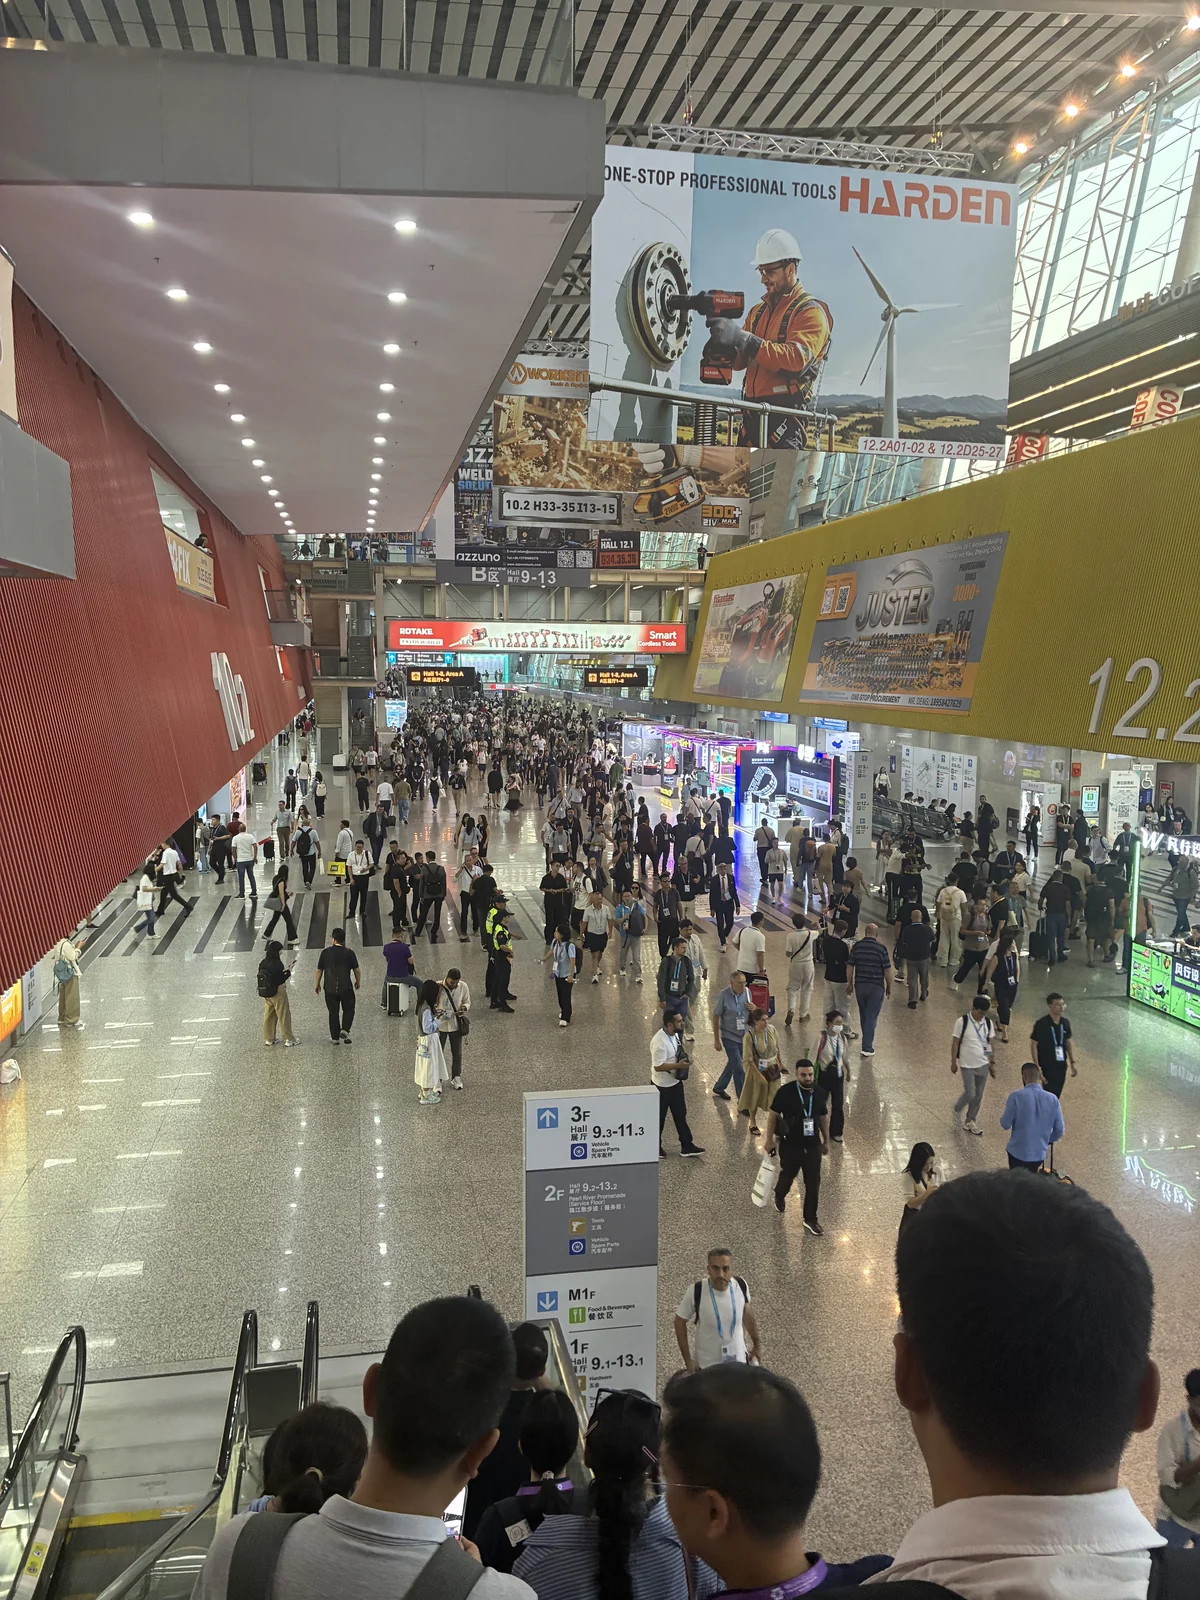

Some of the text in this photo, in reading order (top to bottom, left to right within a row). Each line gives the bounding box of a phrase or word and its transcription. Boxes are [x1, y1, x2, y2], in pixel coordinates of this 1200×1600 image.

[604, 165, 836, 200] ONE-STOP PROFESSIONAL TOOLS
[839, 176, 1011, 226] HARDEN
[863, 439, 1003, 458] 12.2A01-02 & 12.2D25-27
[506, 500, 530, 511] 10.2
[533, 501, 576, 512] H33-35
[600, 540, 634, 549] HALL 12.1
[456, 553, 501, 562] azzuno
[472, 567, 487, 581] B
[521, 570, 557, 584] 9-13
[953, 584, 980, 601] 3000+
[856, 585, 935, 631] JUSTER
[649, 631, 677, 639] Smart
[870, 695, 900, 703] PROCUREMENT
[1088, 657, 1200, 743] 12.2
[571, 1105, 590, 1122] 3F
[571, 1123, 645, 1139] Hall 9.3-11.3
[571, 1133, 587, 1141] 展厅
[544, 1185, 564, 1201] 2F
[582, 1181, 617, 1192] 9.2-13.2
[568, 1287, 596, 1301] M1F
[588, 1311, 613, 1321] 餐饮区
[570, 1338, 589, 1355] 1F
[591, 1353, 643, 1370] 9.1-13.1
